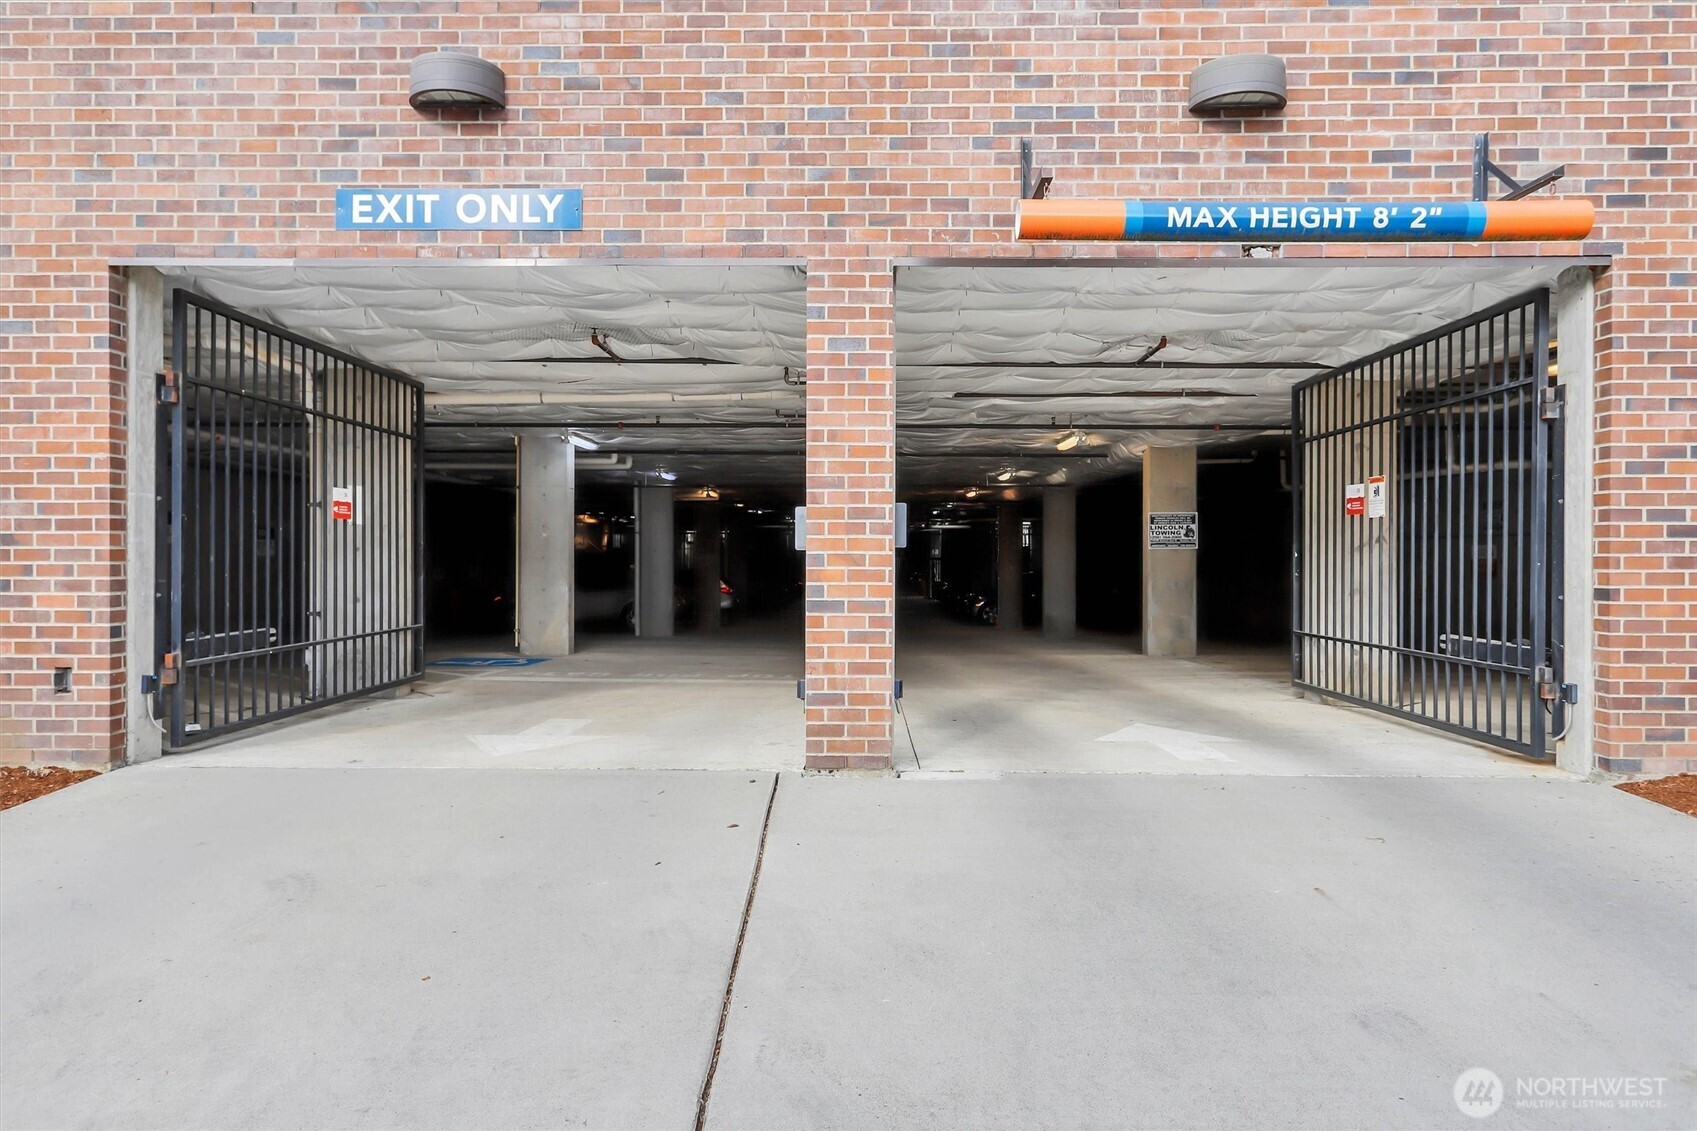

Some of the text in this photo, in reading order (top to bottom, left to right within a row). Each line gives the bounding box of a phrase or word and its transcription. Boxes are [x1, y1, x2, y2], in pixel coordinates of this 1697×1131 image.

[352, 194, 564, 224] EXIT ONLY
[1166, 206, 1238, 229] MAX
[1249, 206, 1361, 229] HEIGHT
